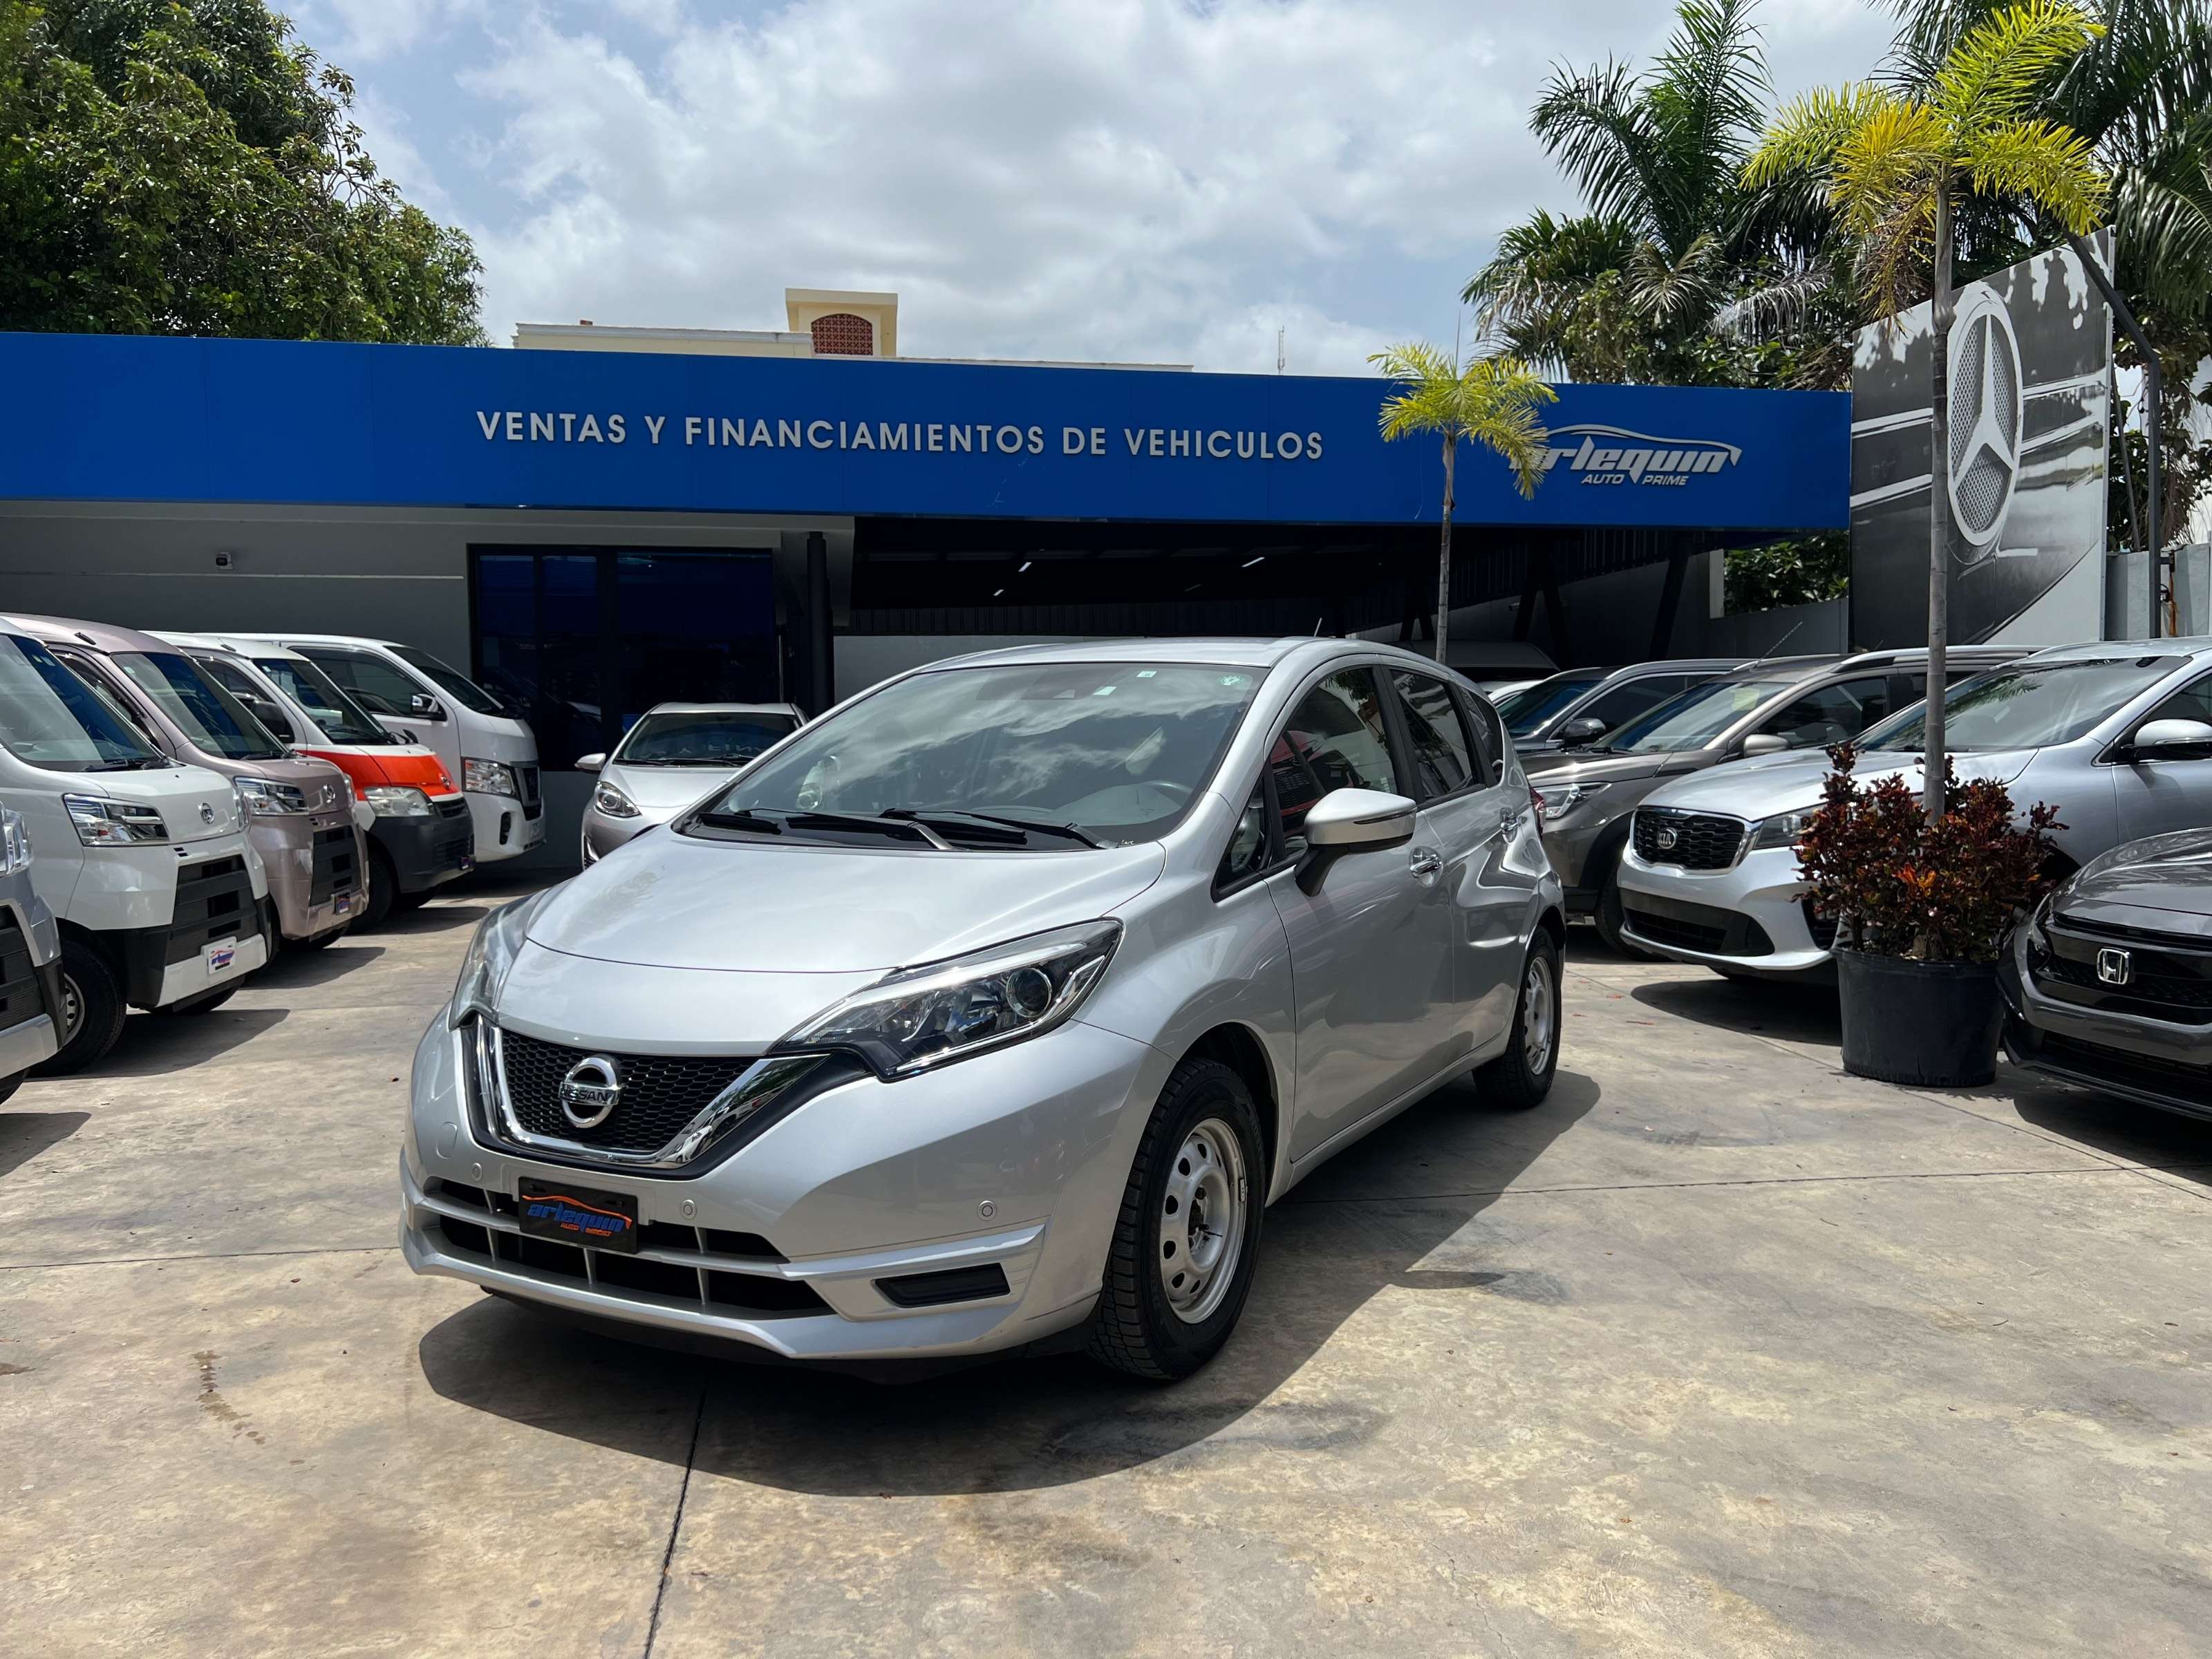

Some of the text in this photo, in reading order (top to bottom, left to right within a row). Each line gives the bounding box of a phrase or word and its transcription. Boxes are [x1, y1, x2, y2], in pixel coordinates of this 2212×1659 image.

[476, 411, 1323, 460] VENTAS Y FINANCIAMIENTOS DE VEHICULOS
[1581, 474, 1689, 486] AUTO PRIME
[527, 1202, 626, 1233] arlequin
